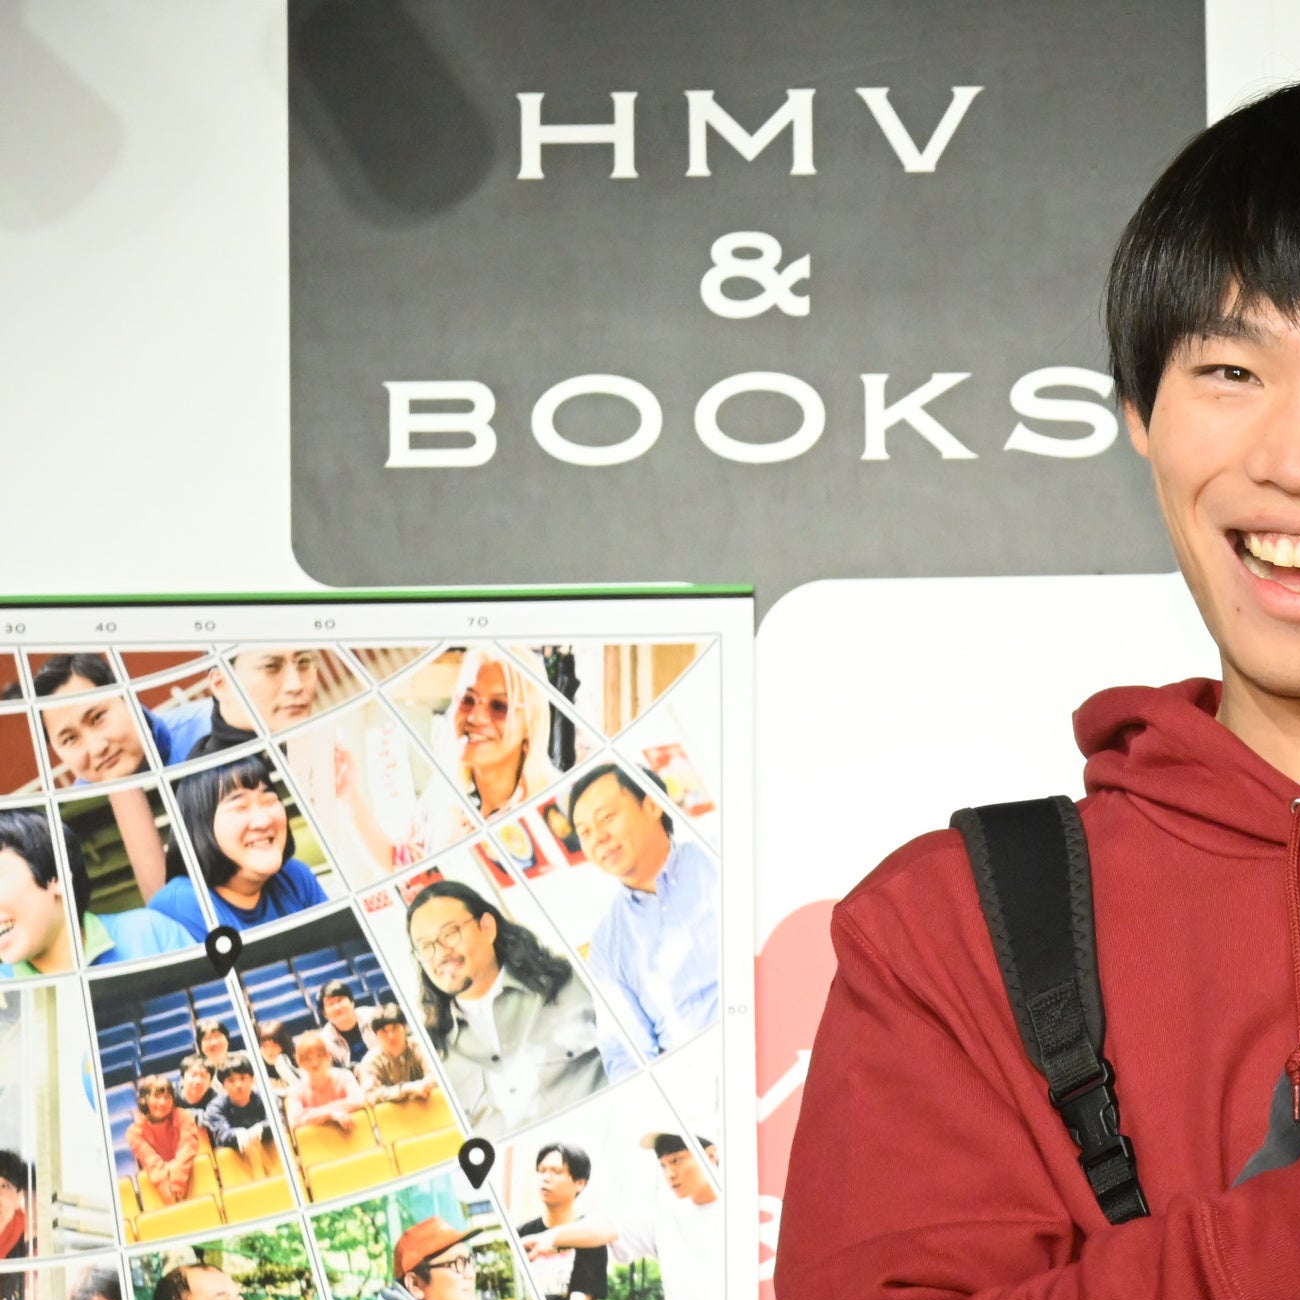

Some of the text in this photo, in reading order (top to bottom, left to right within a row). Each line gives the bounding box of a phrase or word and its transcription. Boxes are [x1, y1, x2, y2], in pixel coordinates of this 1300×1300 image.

[516, 84, 985, 180] HMV
[700, 230, 811, 319] &
[383, 365, 1119, 469] BOOKS
